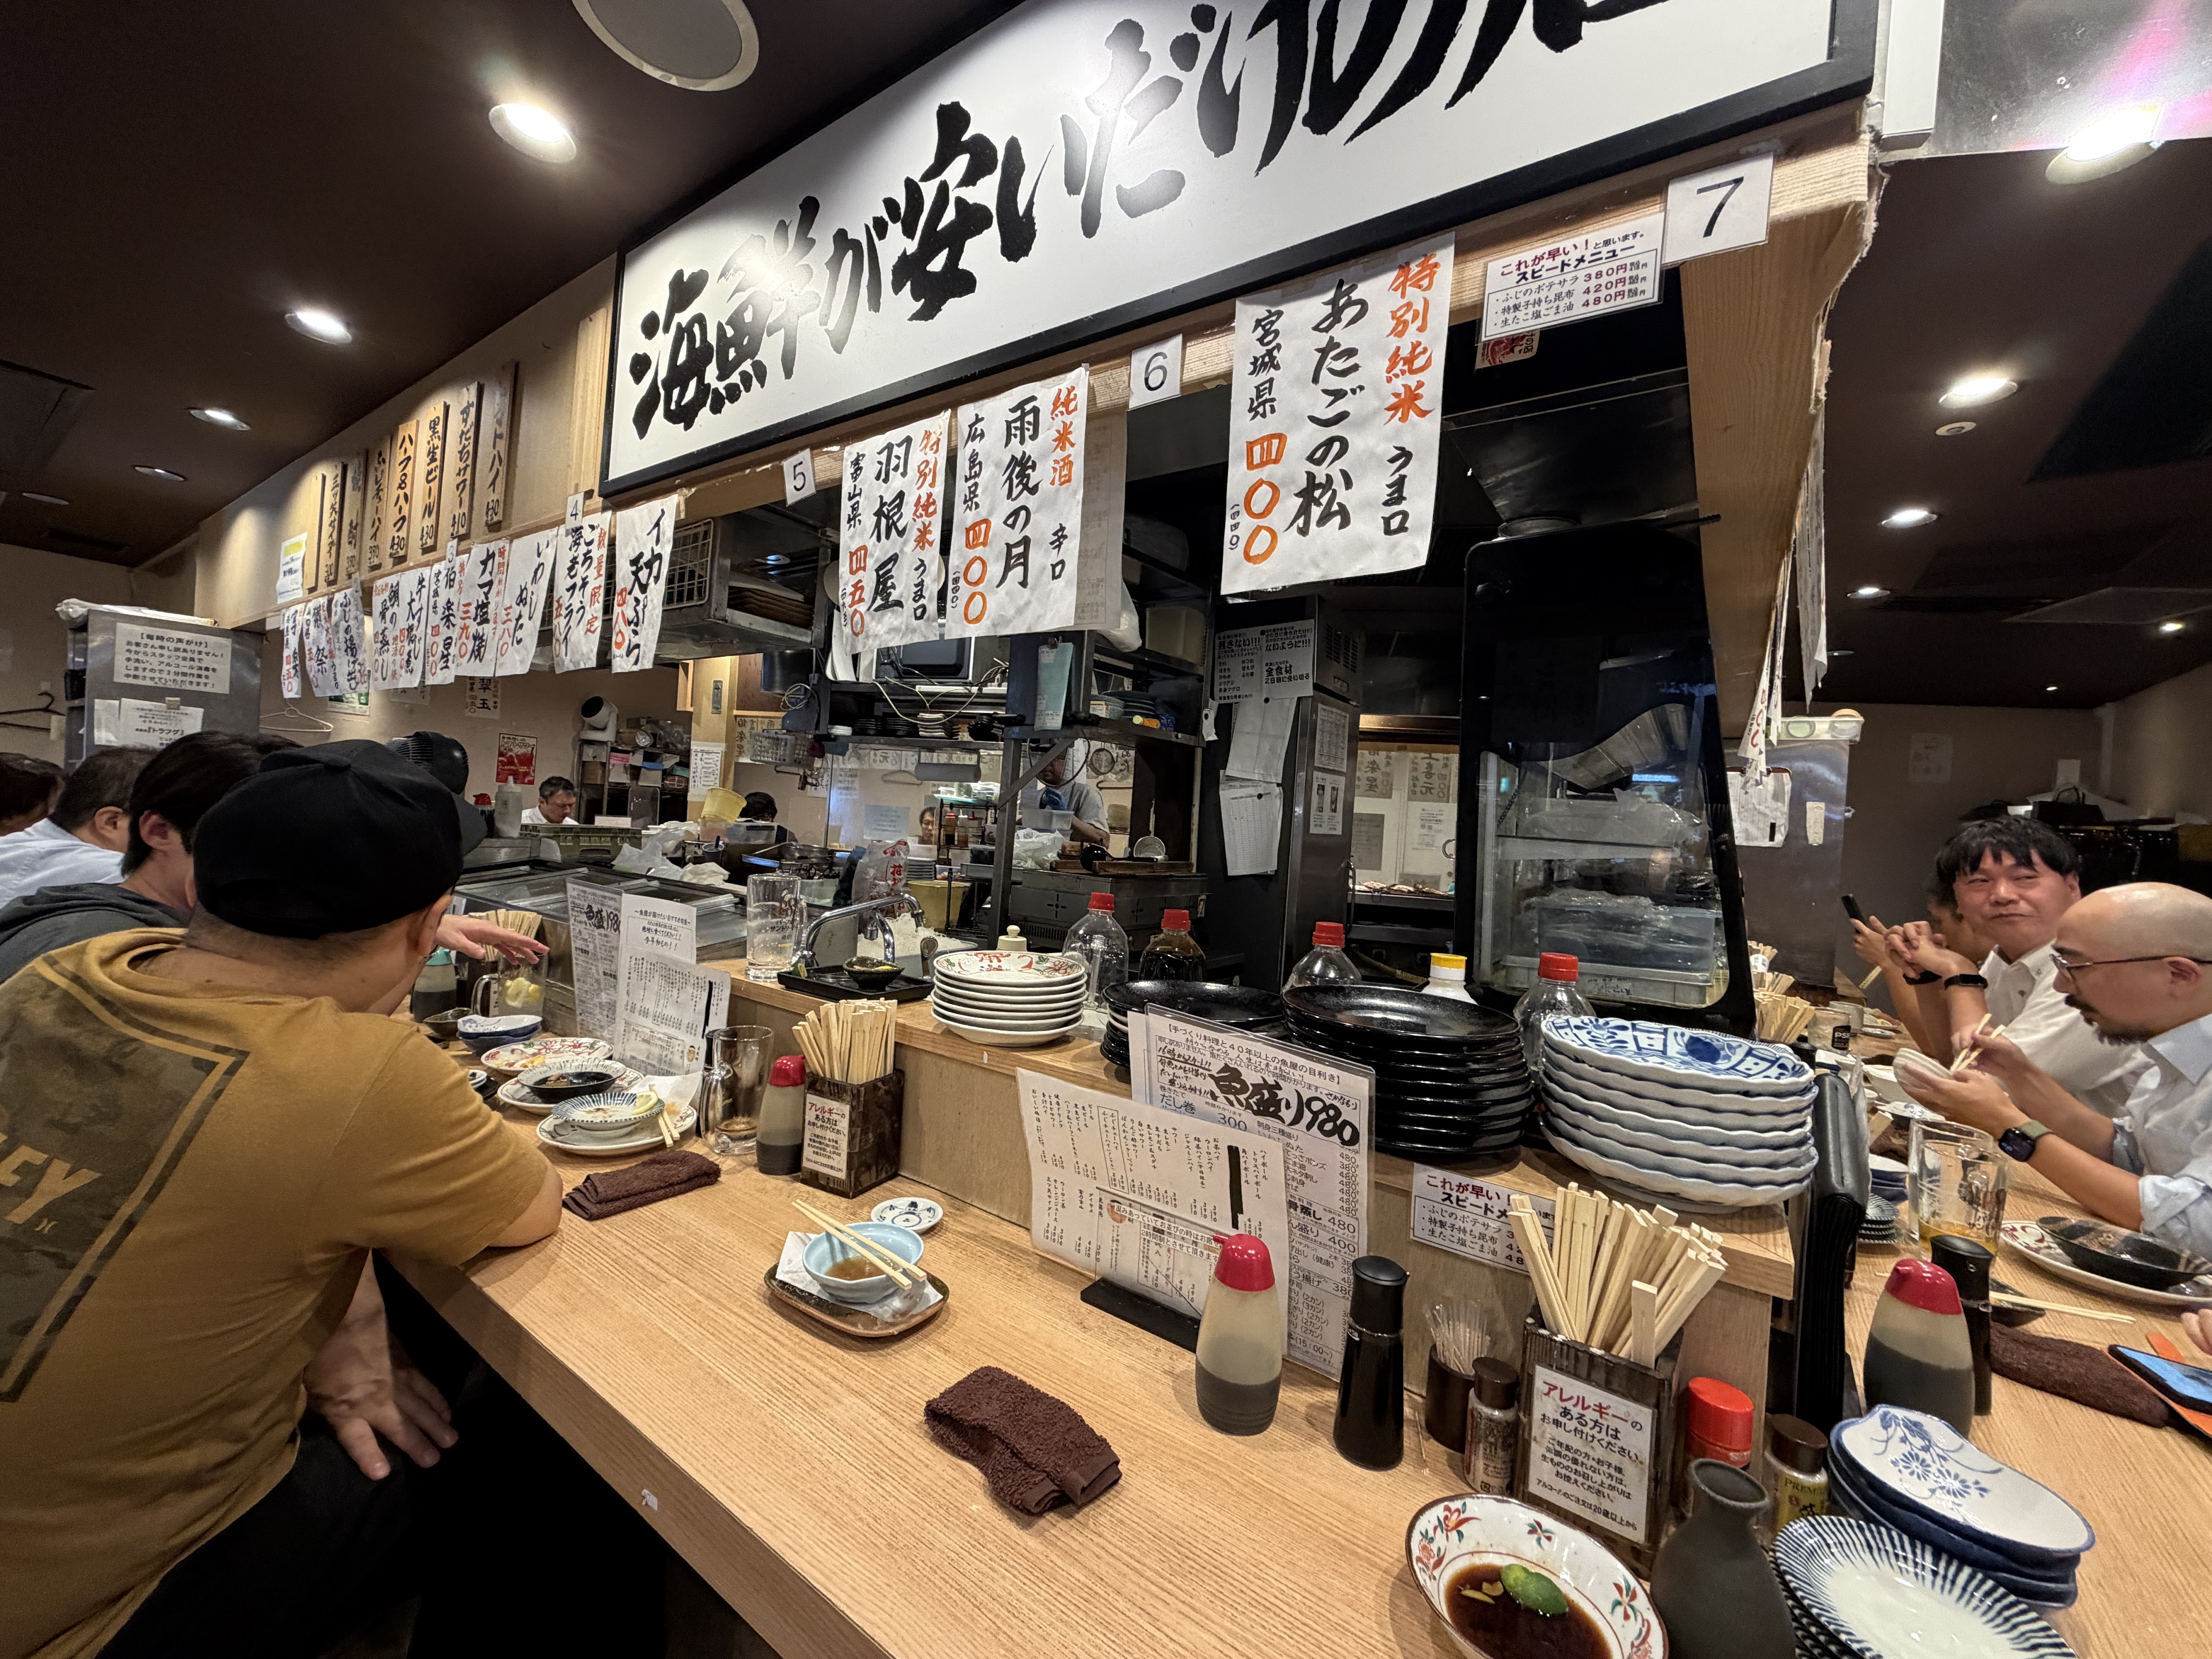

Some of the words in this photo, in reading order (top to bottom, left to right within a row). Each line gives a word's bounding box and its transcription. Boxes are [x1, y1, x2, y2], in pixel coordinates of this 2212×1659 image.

[631, 0, 1659, 440] 海鮮が安いだけの
[1695, 177, 1745, 237] 7
[1500, 239, 1588, 276] これが早い！
[1593, 231, 1644, 250] と思います。
[1516, 245, 1635, 284] スピードメニュー
[1583, 263, 1628, 282] 380円
[1583, 277, 1626, 295] 420円
[1582, 289, 1625, 308] 480円
[1385, 252, 1440, 425] 特別純米
[1145, 353, 1167, 390] 6
[1247, 309, 1282, 422] 宮城県
[1284, 278, 1369, 539] あたごの松
[1049, 385, 1079, 486] 純米酒
[422, 416, 441, 519] 黒生ビール
[456, 401, 474, 509] すだちサワー
[963, 413, 985, 515] 広島県
[793, 461, 806, 491] 5
[846, 451, 866, 532] 富山県
[912, 428, 942, 553] 特別純米
[995, 394, 1043, 590] 雨後の月
[571, 500, 578, 520] 4
[866, 435, 913, 613] 羽根屋
[389, 535, 405, 551] 430
[420, 524, 433, 543] 430
[647, 508, 665, 586] イカ
[1048, 523, 1068, 581] 辛口
[448, 545, 453, 562] 3
[528, 539, 549, 621] いわし
[563, 526, 583, 657] 海老フライ
[575, 524, 599, 627] ごちそう
[584, 528, 606, 635] 数量限定
[414, 572, 426, 660] 牛すじ
[440, 568, 456, 671] 伯楽星
[467, 547, 495, 663] カマ塩焼
[512, 584, 528, 647] ぬた
[625, 552, 648, 669] 天ぷら
[126, 648, 203, 663] 今からスタッフ全員で
[1265, 664, 1292, 677] 全食材
[1265, 673, 1310, 684] 2日目に使い切る
[1169, 1024, 1340, 1084] 【手づくり料理と40年以上の魚屋の目利き】
[809, 1102, 845, 1118] アレルギーの
[1159, 1085, 1186, 1099] 巻きたて
[1160, 1094, 1196, 1114] だし巻
[815, 1114, 837, 1126] ある方は
[1218, 1113, 1247, 1131] 300
[1257, 1121, 1298, 1141] 刺身三種盛り
[1205, 1139, 1213, 1171] ウーロンハイ
[1286, 1142, 1304, 1153] ぬた
[1339, 1152, 1356, 1164] 480
[1339, 1162, 1356, 1173] 380
[1339, 1171, 1356, 1182] 480
[1339, 1180, 1356, 1190] 480
[1339, 1188, 1356, 1199] 480
[1427, 1175, 1511, 1206] これが早い！
[1339, 1197, 1356, 1208] 480
[1339, 1205, 1356, 1216] 480
[1328, 1217, 1355, 1234] 480
[1329, 1236, 1355, 1253] 400
[1542, 1381, 1642, 1432] アレルギーの
[1560, 1406, 1621, 1440] ある方は
[1541, 1454, 1632, 1500] 生もののお召し上がりは
